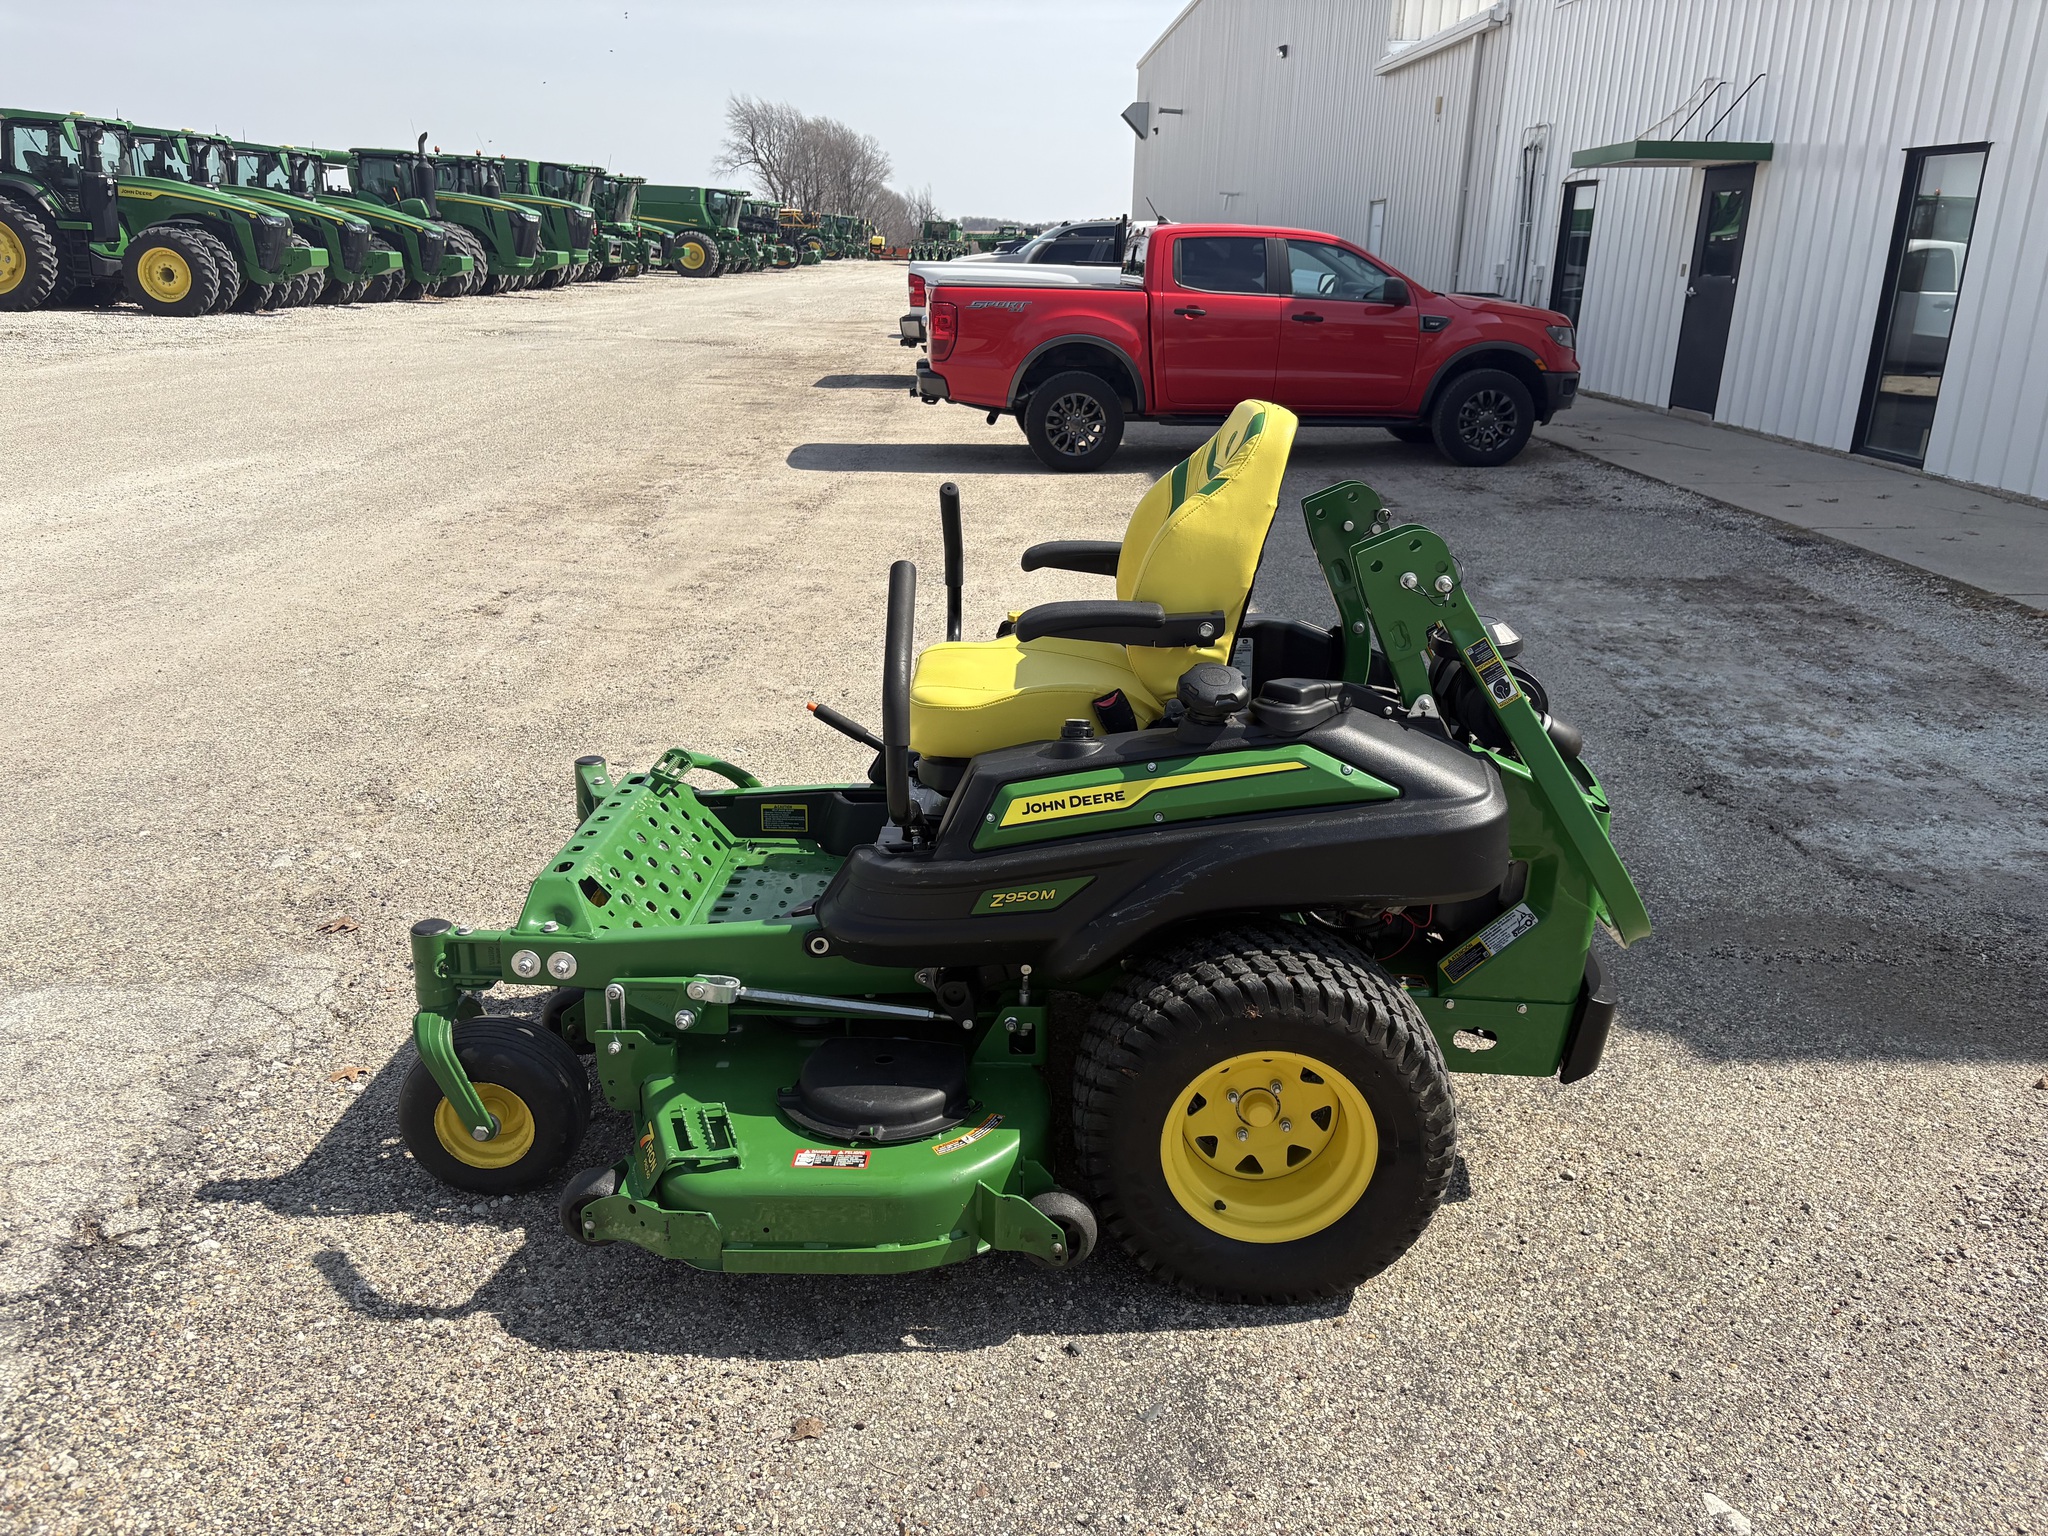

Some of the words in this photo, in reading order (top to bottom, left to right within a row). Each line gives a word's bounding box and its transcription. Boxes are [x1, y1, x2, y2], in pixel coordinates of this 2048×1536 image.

[135, 189, 152, 197] DEERE
[965, 300, 1033, 310] SPORT
[1022, 799, 1066, 816] JOHN
[1069, 790, 1125, 808] DEERE
[990, 889, 1056, 908] Z950M
